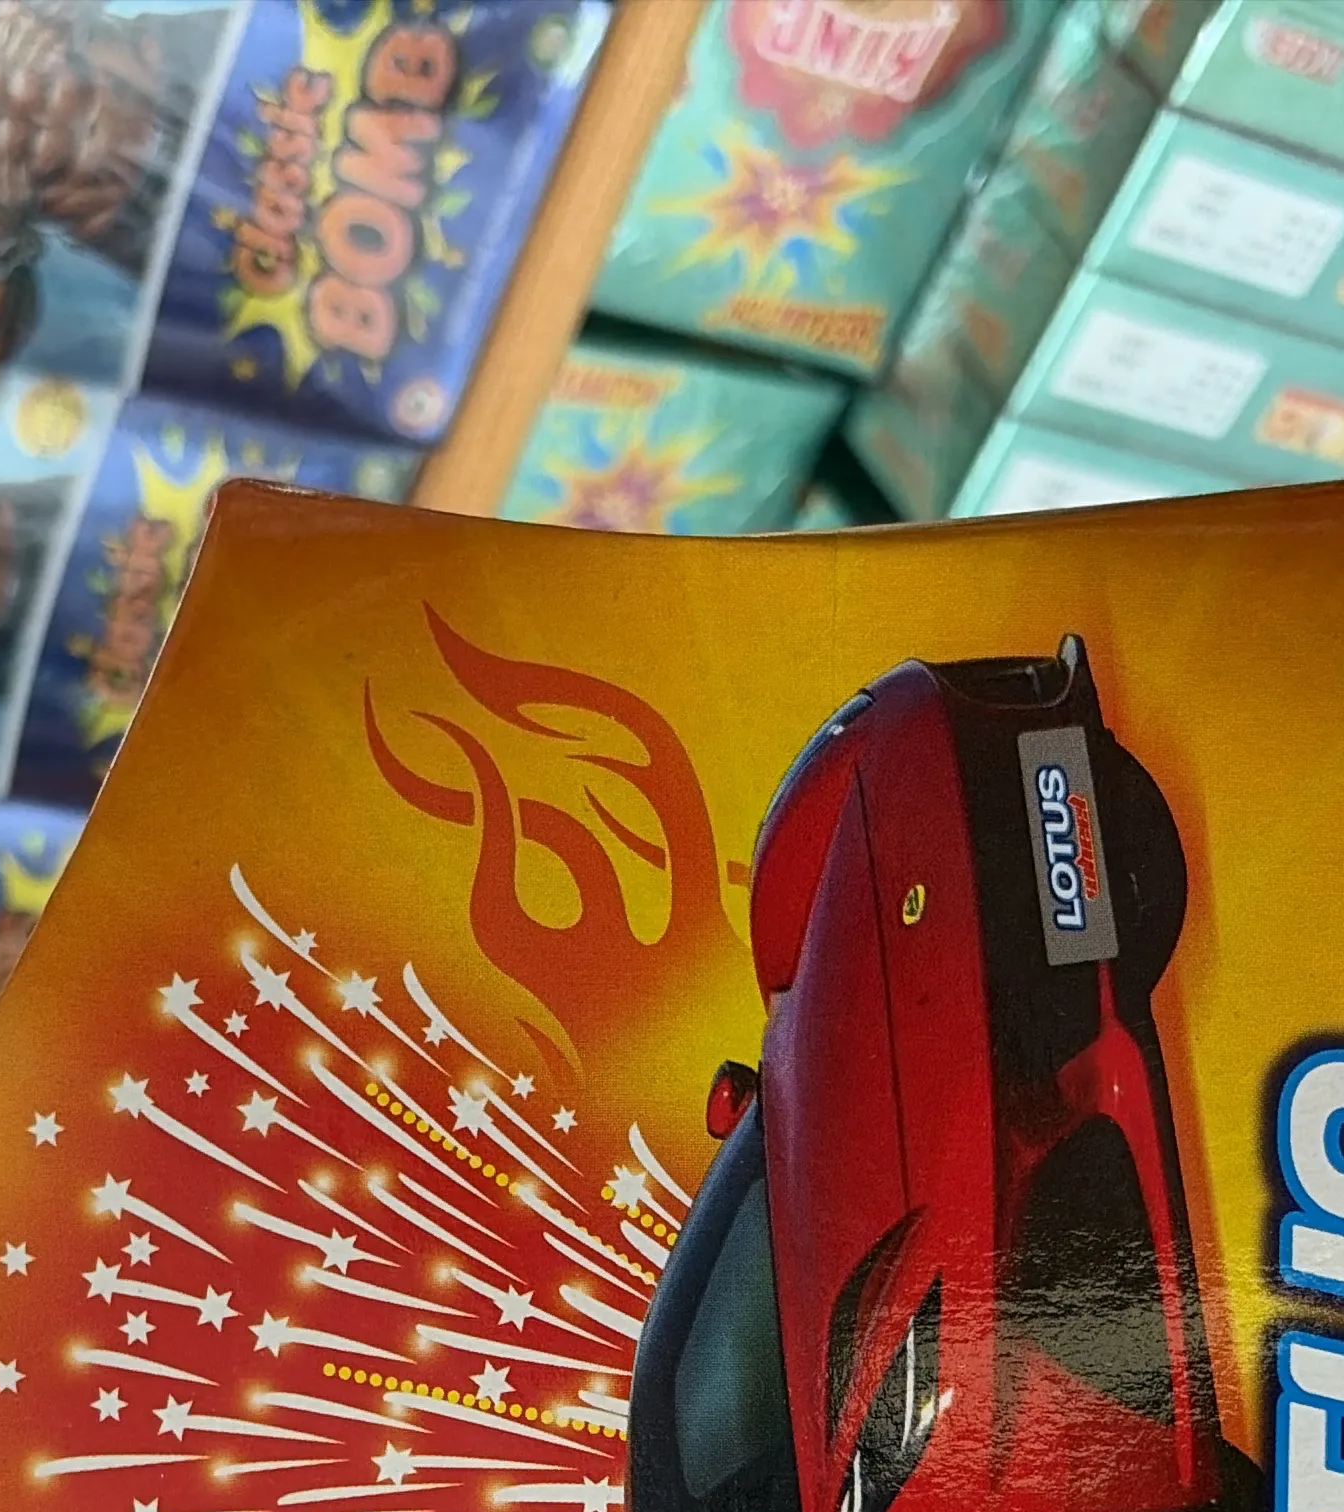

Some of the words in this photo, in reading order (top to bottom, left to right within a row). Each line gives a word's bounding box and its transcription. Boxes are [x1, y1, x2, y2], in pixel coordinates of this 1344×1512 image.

[232, 68, 333, 298] Classic
[308, 27, 457, 359] BOMB
[1035, 764, 1086, 930] LOTUS
